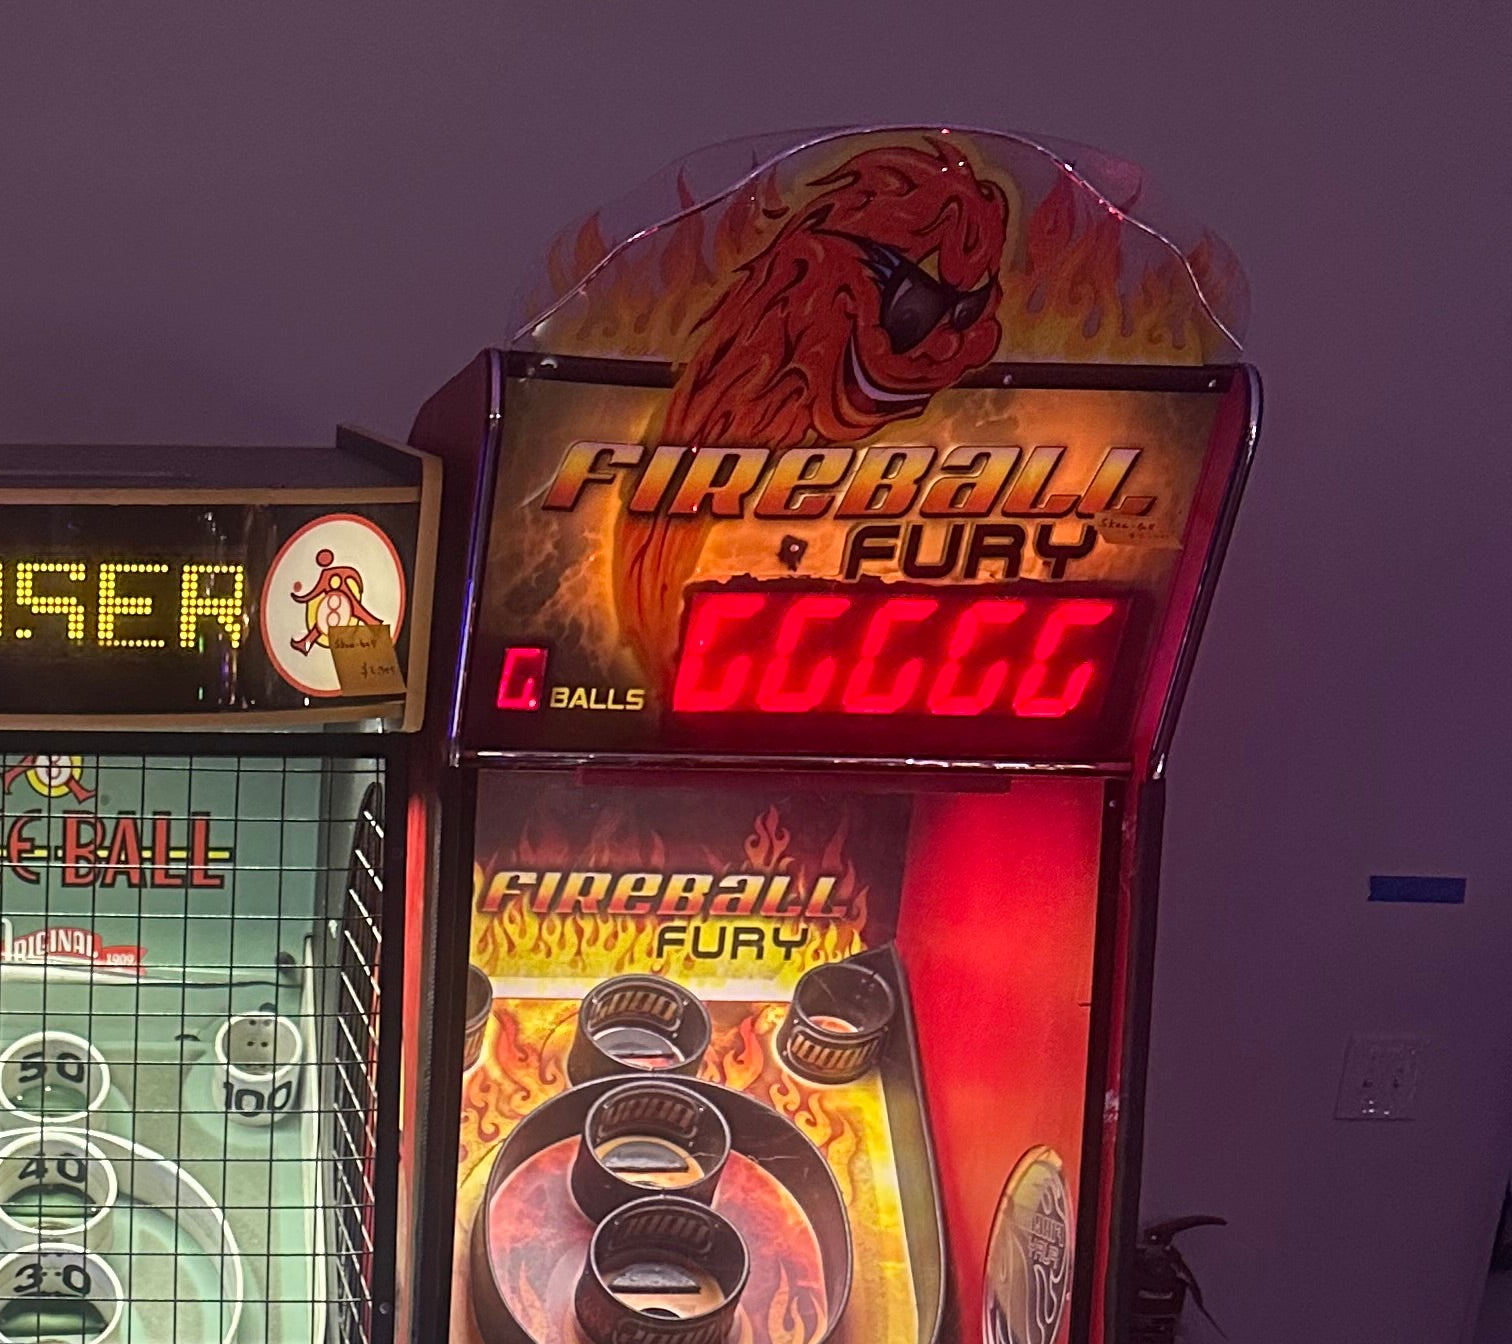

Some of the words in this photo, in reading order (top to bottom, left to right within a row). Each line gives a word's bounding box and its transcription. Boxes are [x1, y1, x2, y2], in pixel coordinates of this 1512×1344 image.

[542, 441, 1158, 520] FIREBALL
[844, 522, 1099, 581] FURY
[550, 686, 646, 711] BALLS
[484, 870, 853, 919] FIREBALL
[655, 926, 810, 962] FURY
[17, 1051, 87, 1085] 50
[17, 1152, 87, 1184] 40
[13, 1263, 91, 1296] 30
